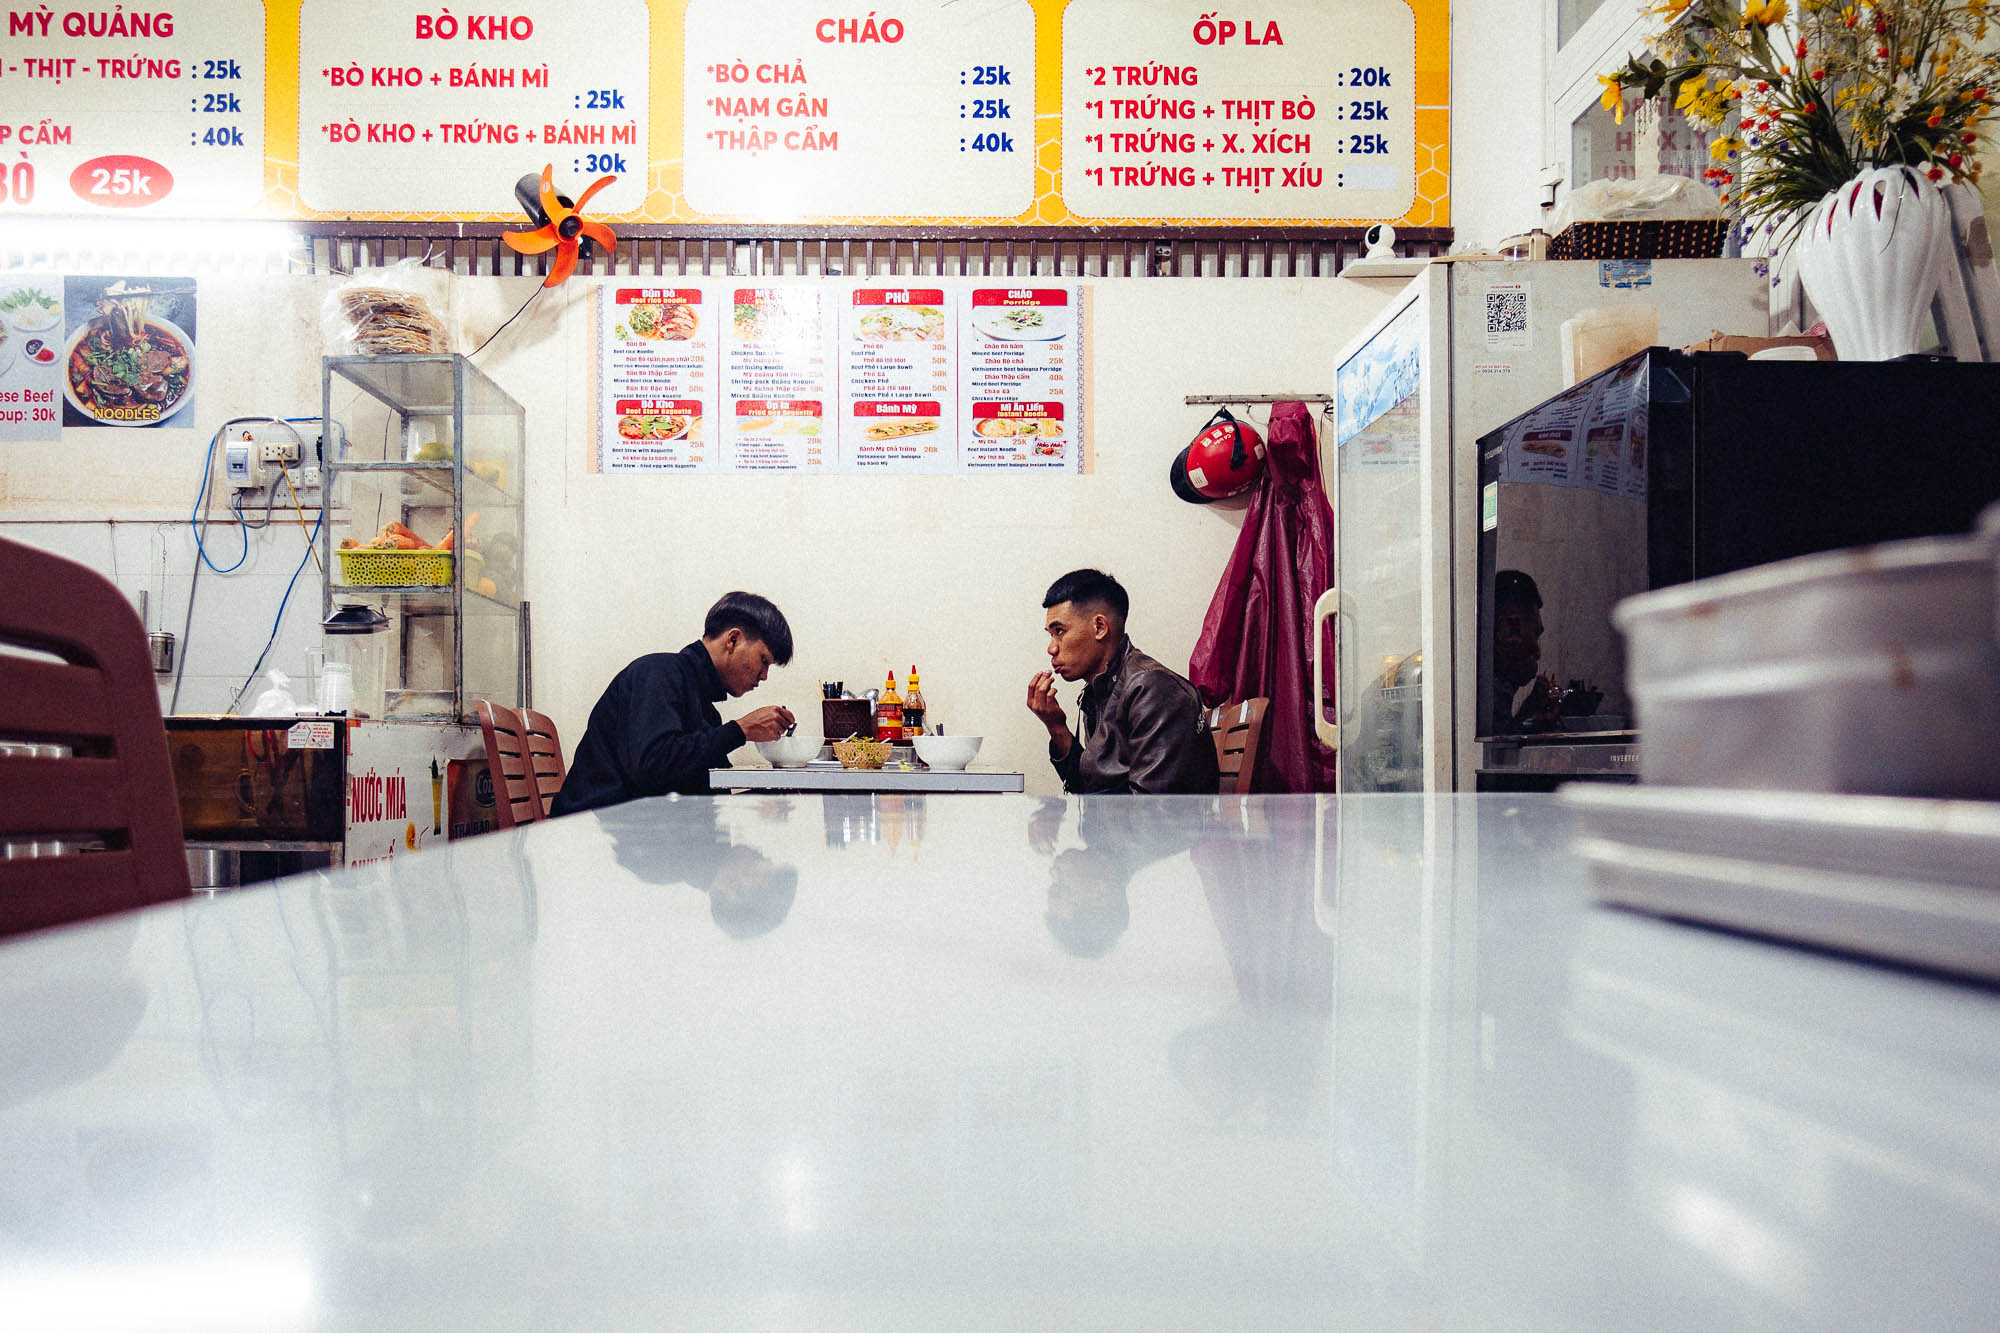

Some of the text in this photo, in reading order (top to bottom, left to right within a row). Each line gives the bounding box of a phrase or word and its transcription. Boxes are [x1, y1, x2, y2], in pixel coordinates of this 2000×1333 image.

[10, 5, 173, 37] MỲ QUẢNG
[416, 8, 533, 40] BÒ KHO
[816, 12, 904, 43] CHÁO
[1194, 12, 1283, 45] ỐP LA
[24, 59, 76, 84] THỊT
[97, 54, 180, 78] TRỨNG
[204, 60, 240, 78] 25k
[372, 68, 422, 86] KHO
[450, 63, 514, 87] BÁNH
[522, 64, 548, 87] MÌ
[756, 59, 806, 83] CHẢ
[973, 66, 1010, 84] 25k
[1113, 61, 1197, 86] TRỨNG
[1351, 67, 1390, 86] 20k
[204, 93, 240, 112] 25k
[587, 90, 624, 108] 25k
[973, 99, 1010, 118] 25k
[1110, 94, 1195, 119] TRỨNG
[1222, 100, 1275, 126] THỊT
[1282, 95, 1315, 120] BÒ
[1351, 101, 1387, 120] 25k
[19, 119, 71, 144] CẨM
[203, 128, 242, 145] 40k
[369, 124, 415, 142] KHO
[440, 119, 518, 143] TRỨNG
[544, 119, 605, 144] BÁNH
[611, 119, 636, 144] MÌ
[785, 125, 837, 150] CẨM
[972, 133, 1013, 152] 40k
[1110, 128, 1195, 152] TRỨNG
[1253, 129, 1310, 153] XÍCH
[1351, 135, 1387, 153] 25k
[587, 154, 625, 172] 30k
[91, 168, 152, 196] 25k
[1110, 161, 1195, 186] TRỨNG
[1222, 168, 1274, 193] THỊT
[1282, 162, 1322, 187] XÍU
[24, 389, 54, 402] Beef
[32, 408, 56, 421] 30k
[94, 408, 160, 420] NOODLES
[876, 404, 917, 413] Bánh Mỳ
[352, 767, 407, 823] NƯỚC MÍA
